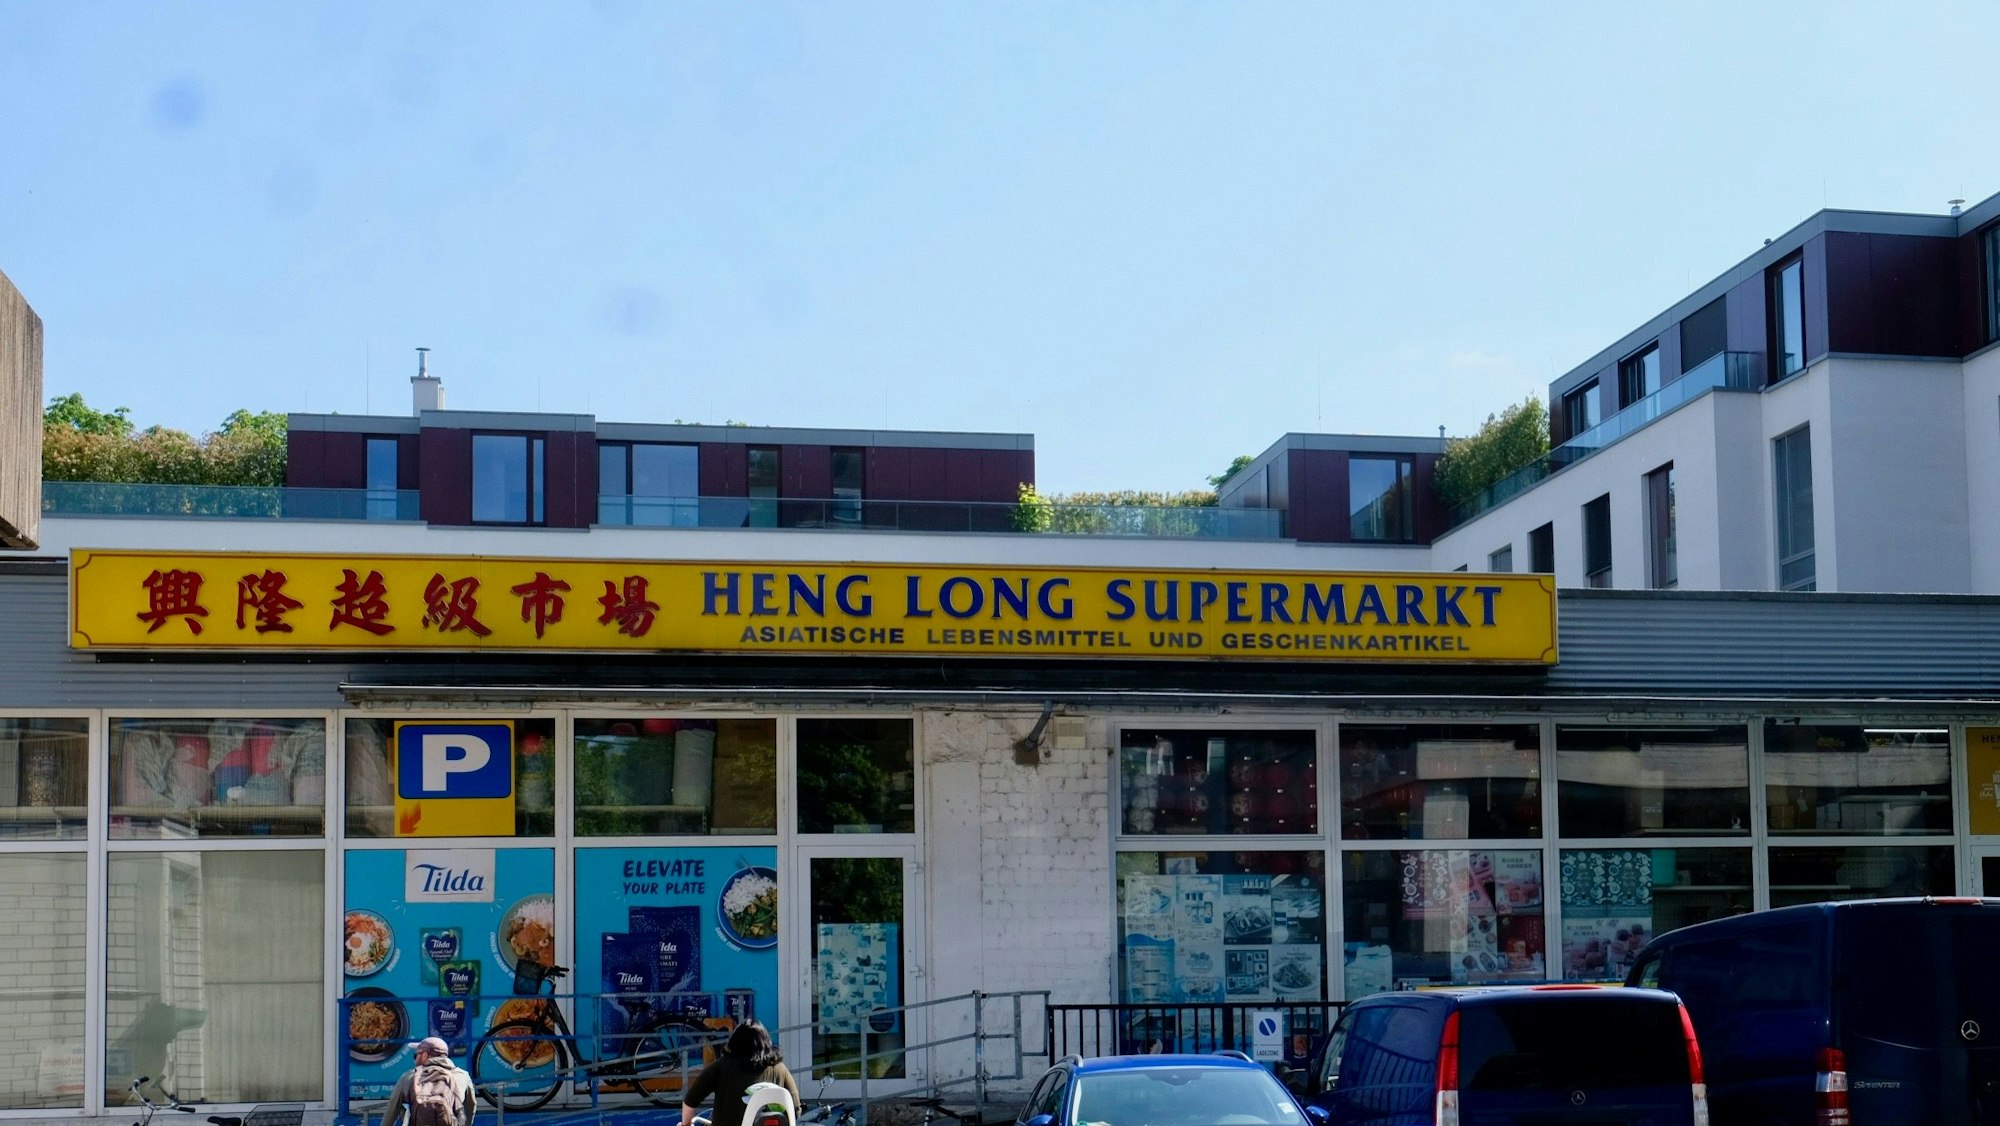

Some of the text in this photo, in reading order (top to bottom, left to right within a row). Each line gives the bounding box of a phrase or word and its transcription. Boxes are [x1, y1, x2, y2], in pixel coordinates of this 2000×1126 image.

[137, 569, 660, 639] 興隆超級市場
[702, 572, 1503, 628] HENG LONG SUPERMARKT
[741, 625, 1470, 652] ASIATISCHE LEBENSMITTEL UND GESCHENKARTIKEL
[422, 734, 491, 792] P
[623, 859, 705, 878] ELEVATE
[413, 864, 484, 892] Tilda
[623, 882, 706, 895] YOUR PLATE
[430, 939, 451, 948] Tilda
[448, 972, 469, 981] Tilda
[616, 972, 644, 983] Tilda
[438, 1010, 458, 1018] Tilda
[1854, 1080, 1900, 1089] SPRINTER
